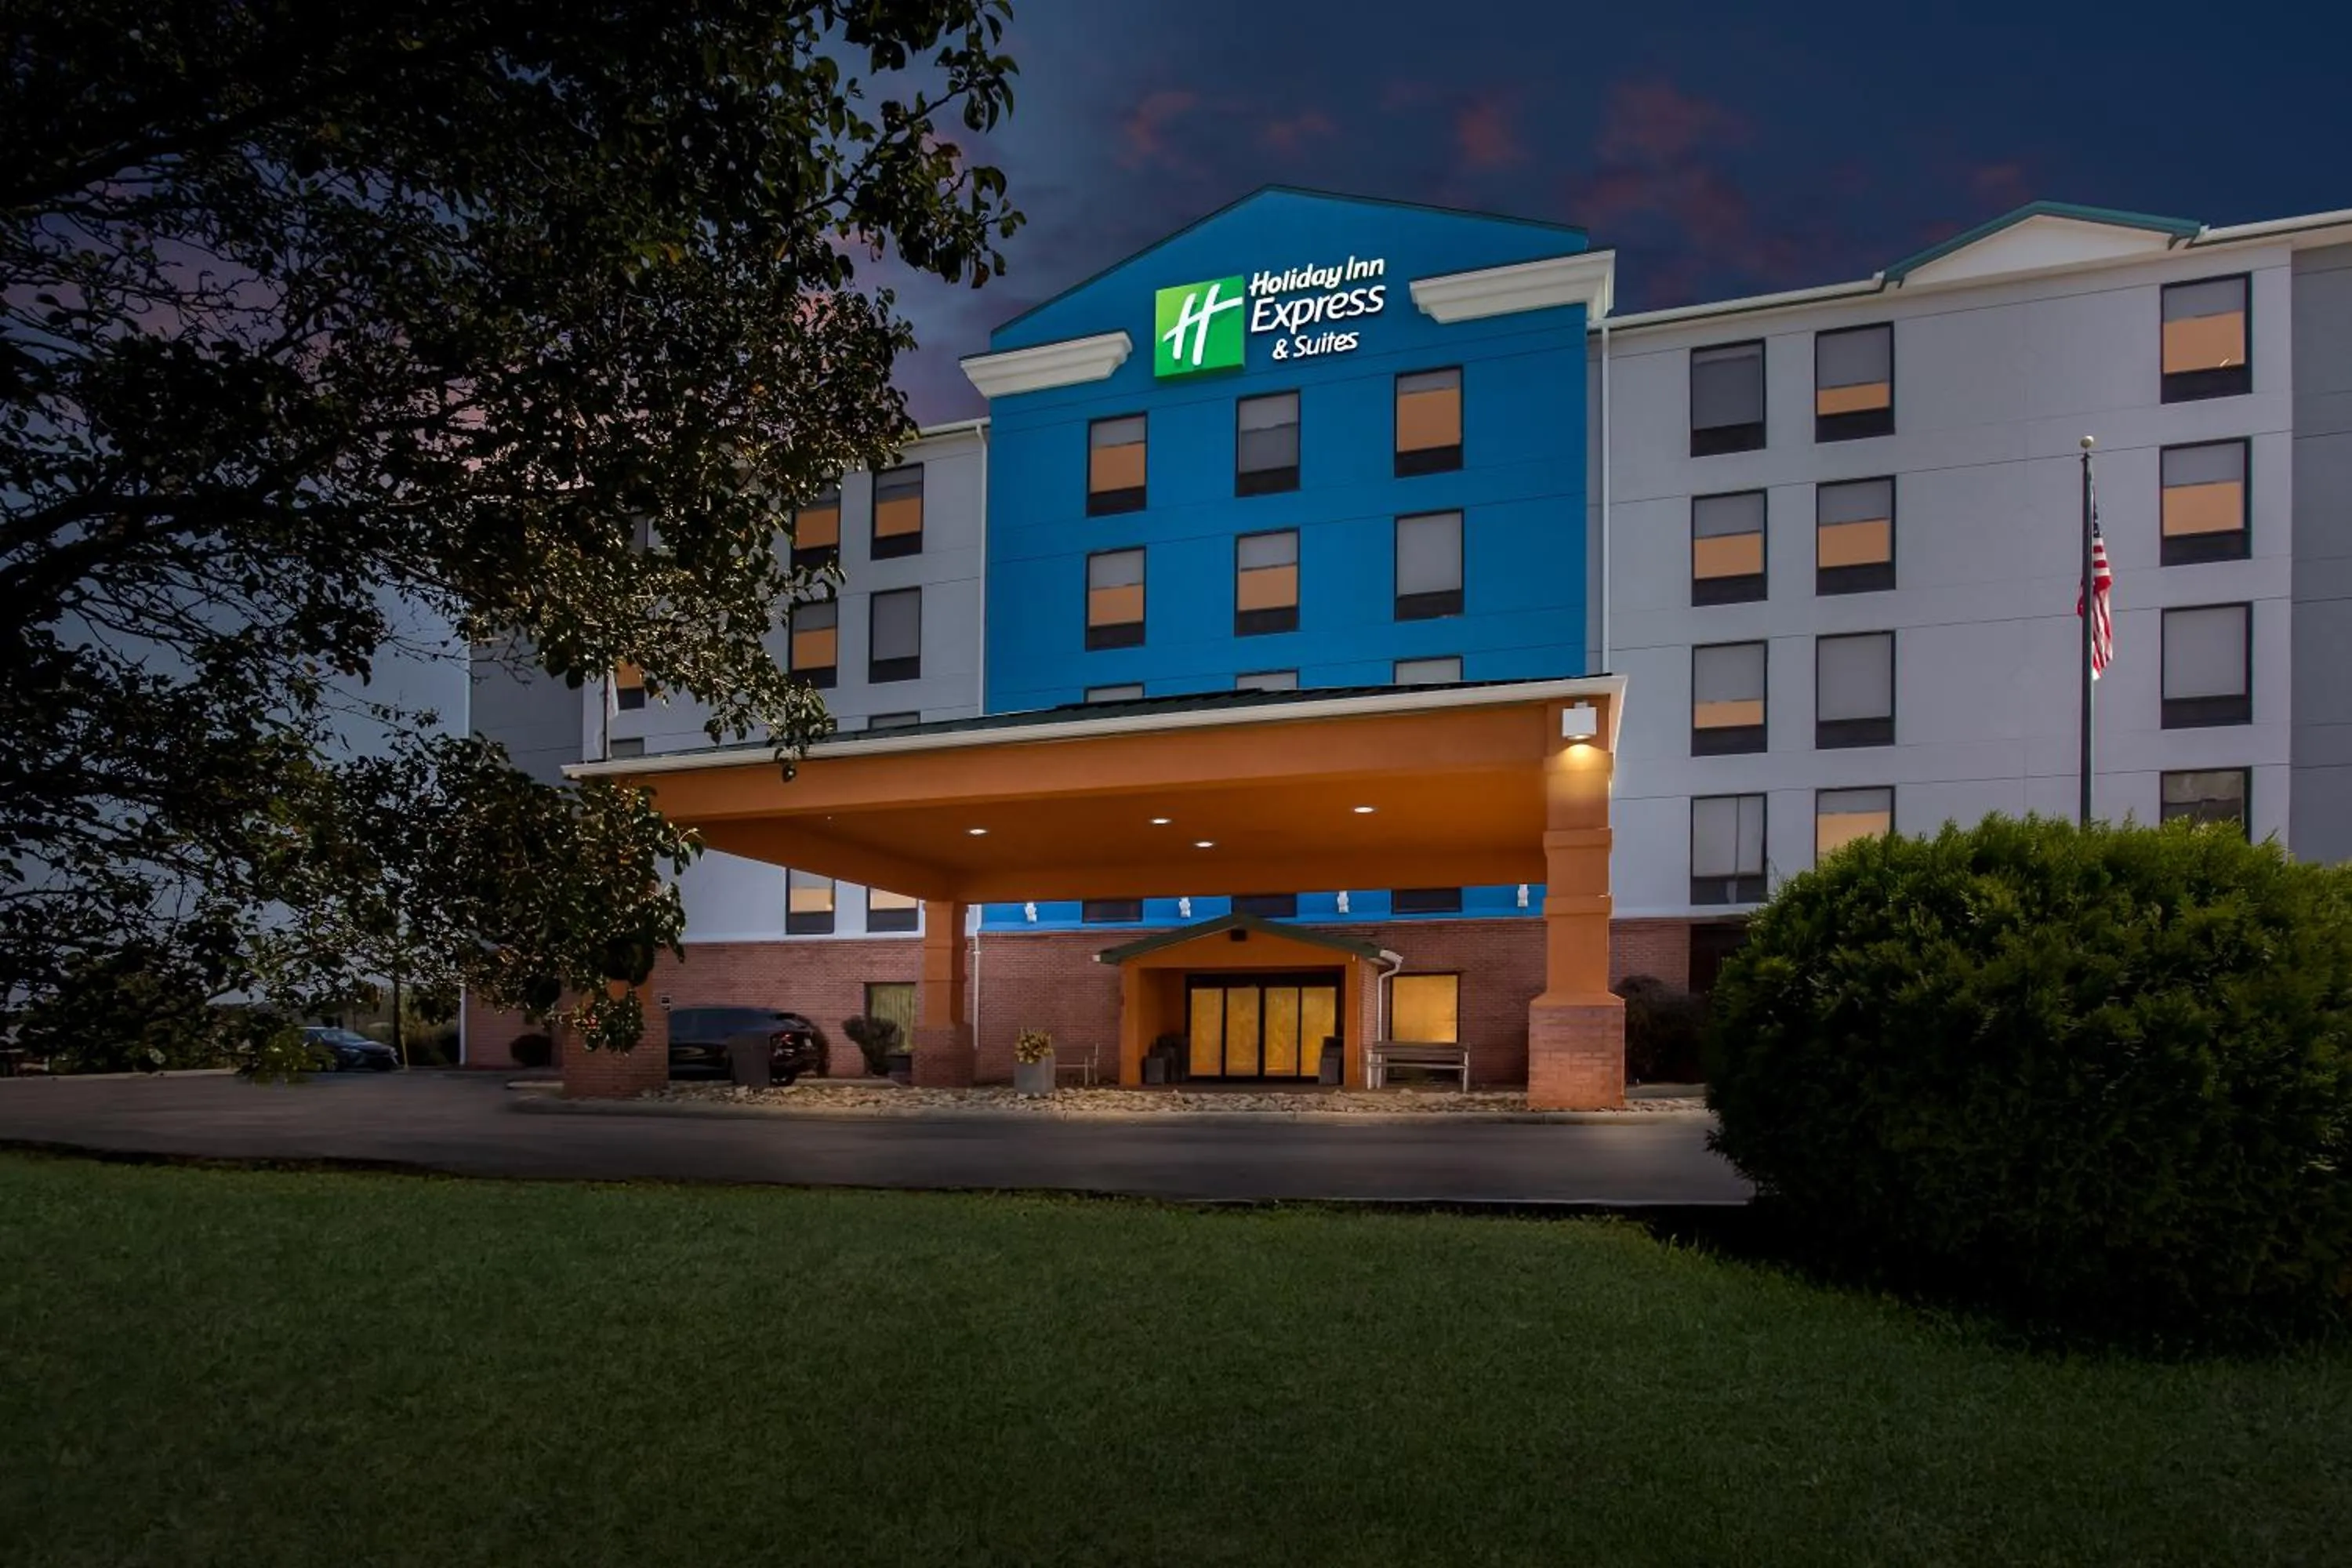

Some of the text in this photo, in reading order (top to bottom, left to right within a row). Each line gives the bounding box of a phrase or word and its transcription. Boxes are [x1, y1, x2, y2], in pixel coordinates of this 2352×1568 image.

[1249, 256, 1385, 296] Holiday Inn
[1250, 285, 1386, 334] Express
[1272, 332, 1359, 360] & Suites
